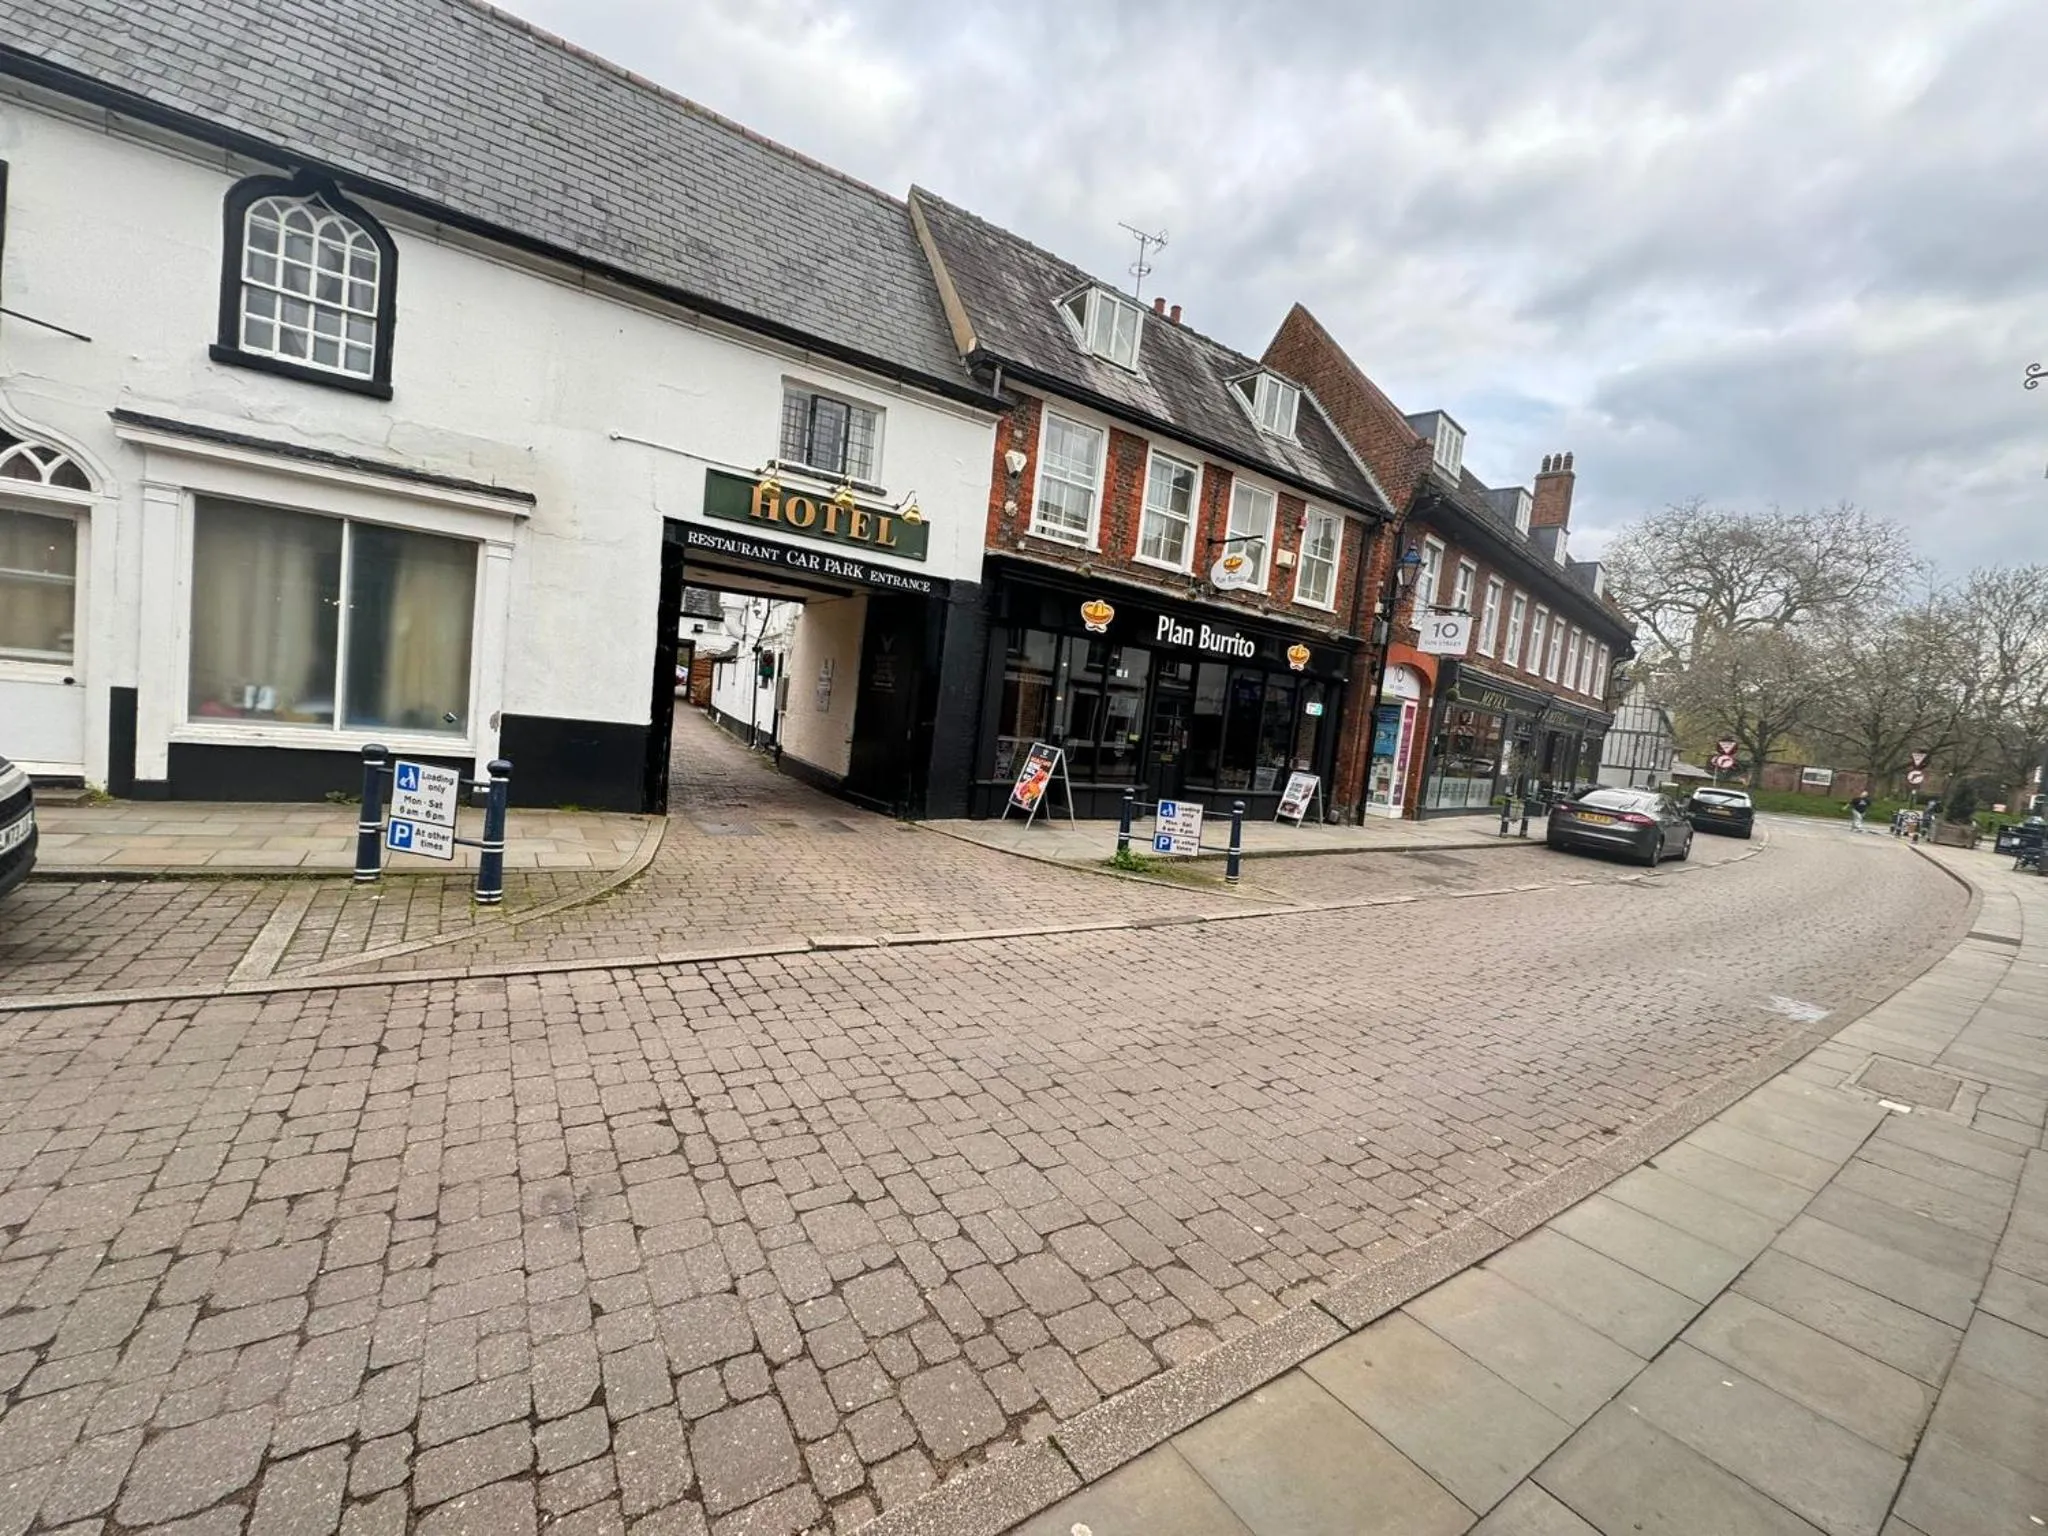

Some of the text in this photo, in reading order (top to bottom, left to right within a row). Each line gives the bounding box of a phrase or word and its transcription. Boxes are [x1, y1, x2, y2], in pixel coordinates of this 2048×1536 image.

[750, 485, 898, 547] HOTEL
[687, 530, 931, 593] RESTAURANT CAR PARK ENTRANCE
[1156, 615, 1255, 658] Plan Burrito
[1432, 622, 1459, 638] 10
[421, 771, 454, 786] Loading
[428, 783, 446, 794] only
[403, 794, 422, 806] Mon
[428, 799, 443, 810] Sat
[406, 808, 419, 816] am
[432, 813, 446, 821] pm
[415, 827, 450, 842] At other
[420, 839, 443, 851] times
